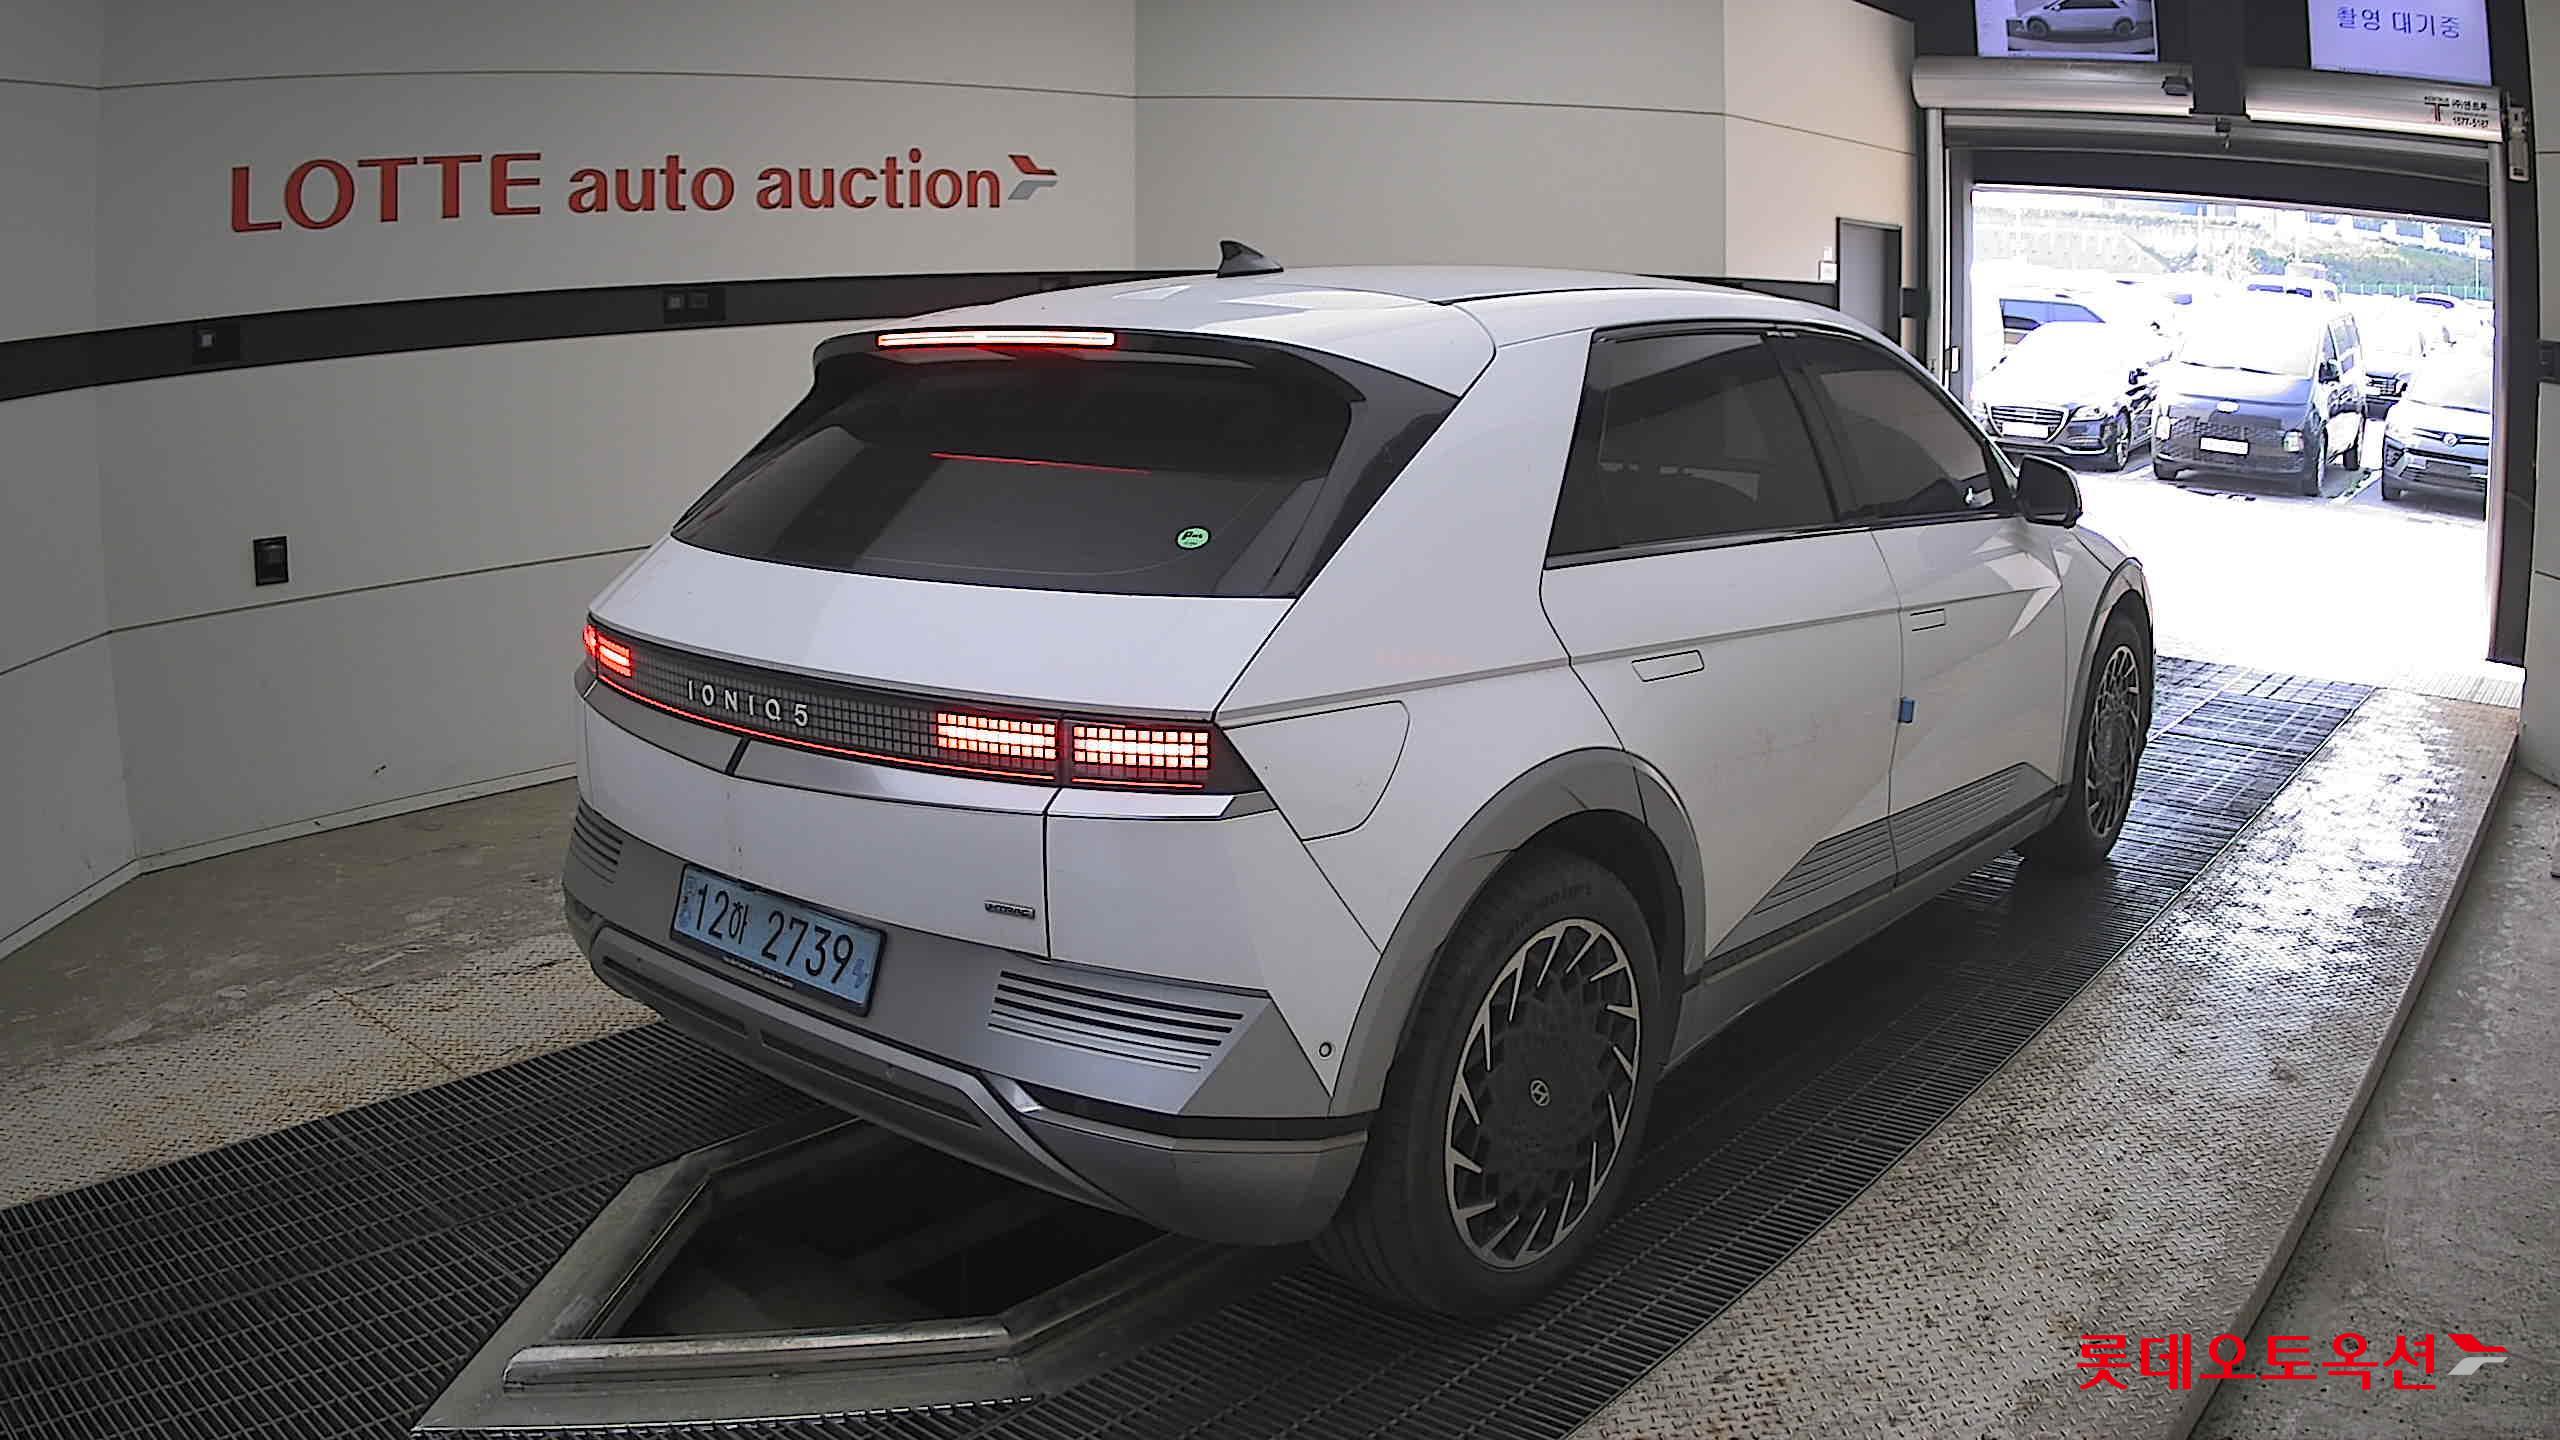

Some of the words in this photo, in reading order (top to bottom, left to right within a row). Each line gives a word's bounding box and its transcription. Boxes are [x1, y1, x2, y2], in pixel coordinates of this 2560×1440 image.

[2337, 6, 2382, 31] 촬영
[2392, 12, 2460, 39] 대기중
[231, 152, 543, 233] LOTTE
[568, 155, 736, 213] auto
[756, 148, 1001, 210] auction
[688, 680, 782, 722] IONIQ
[794, 703, 809, 727] 5
[695, 883, 751, 945] 12하
[760, 909, 854, 985] 2739
